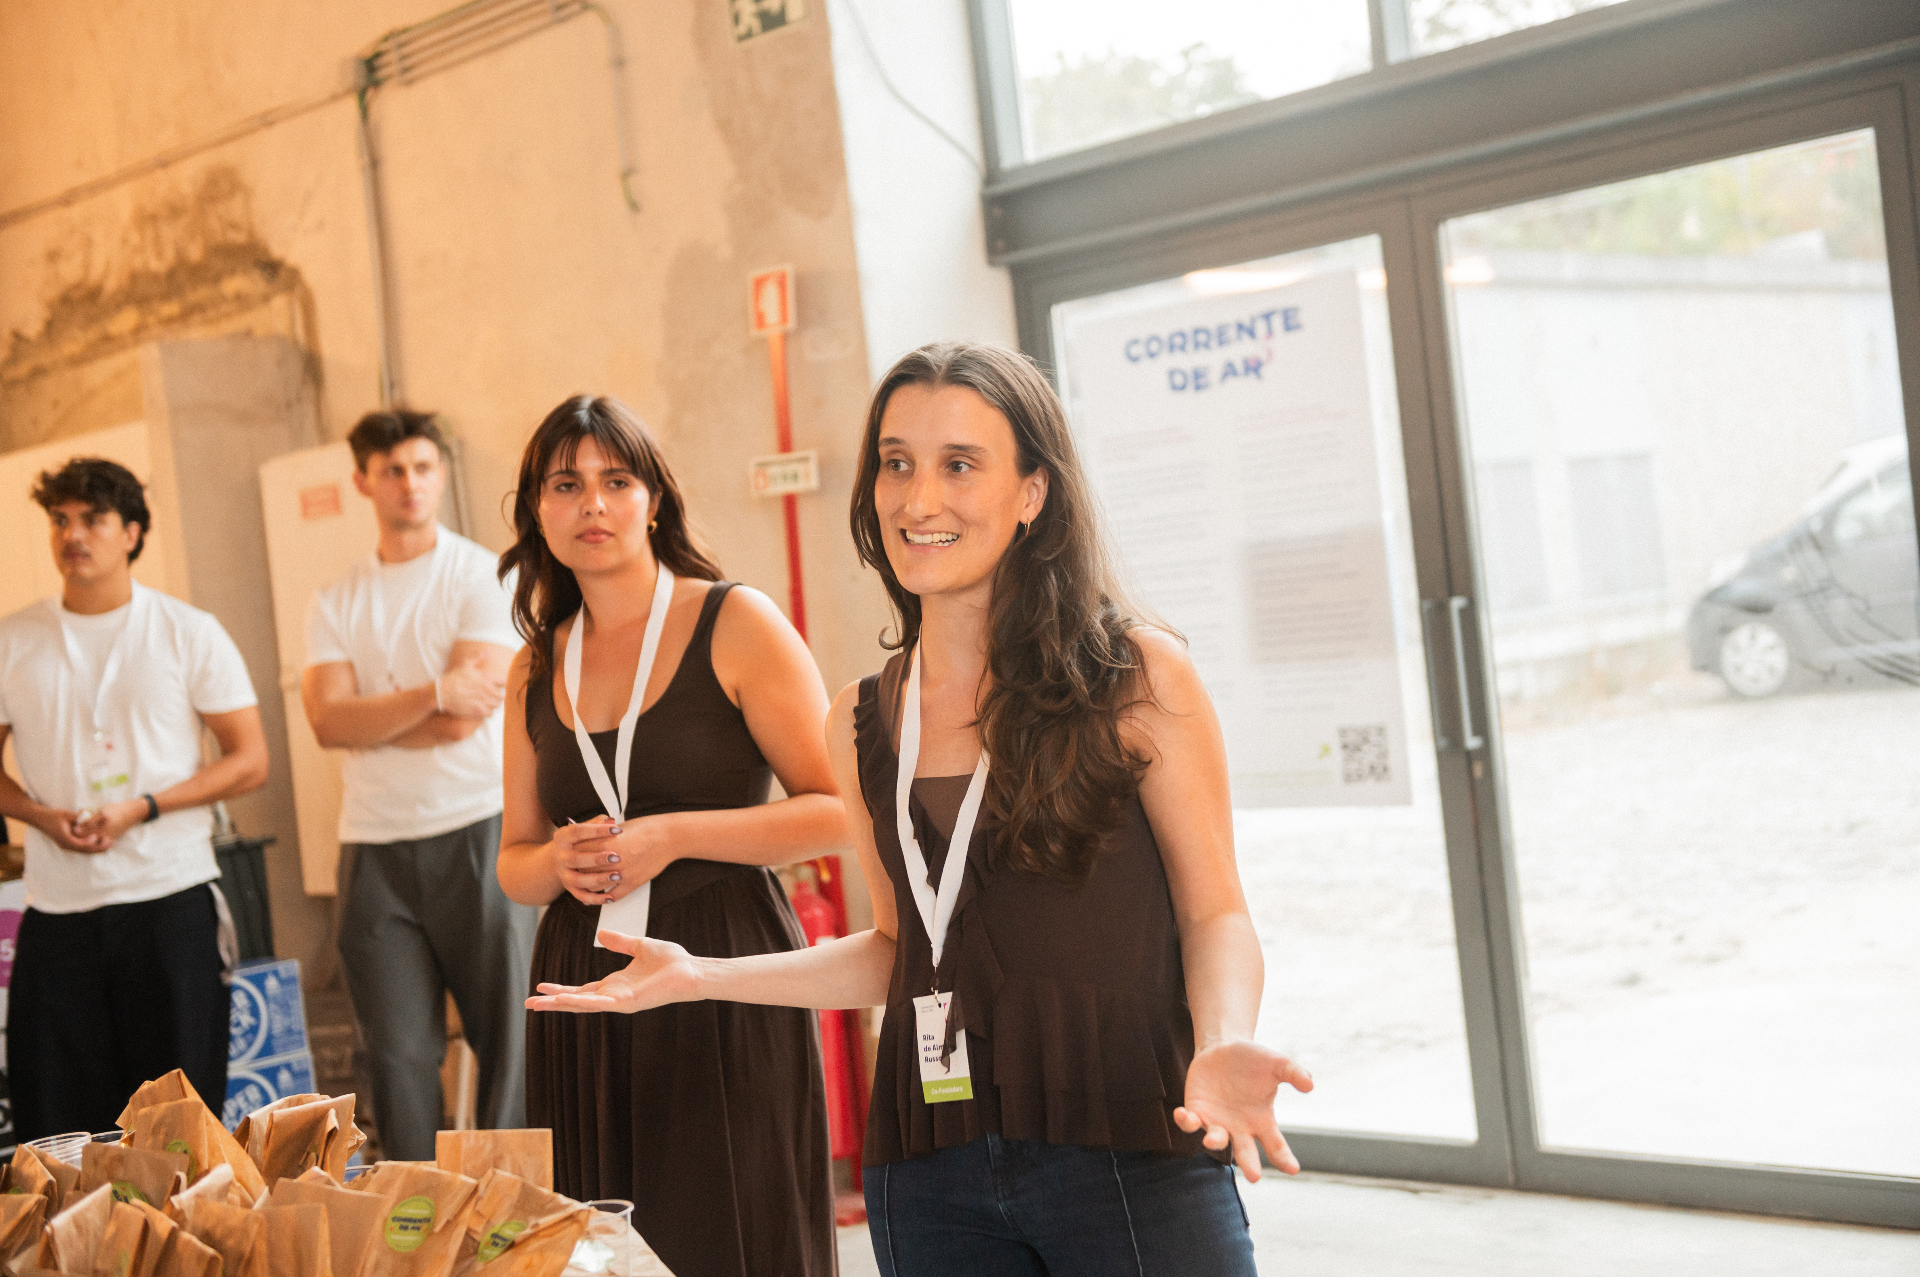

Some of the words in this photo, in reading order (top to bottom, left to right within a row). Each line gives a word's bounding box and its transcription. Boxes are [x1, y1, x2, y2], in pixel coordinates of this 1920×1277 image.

[1124, 306, 1303, 363] CORRENTE
[1168, 366, 1210, 392] DE
[1219, 357, 1264, 385] AR
